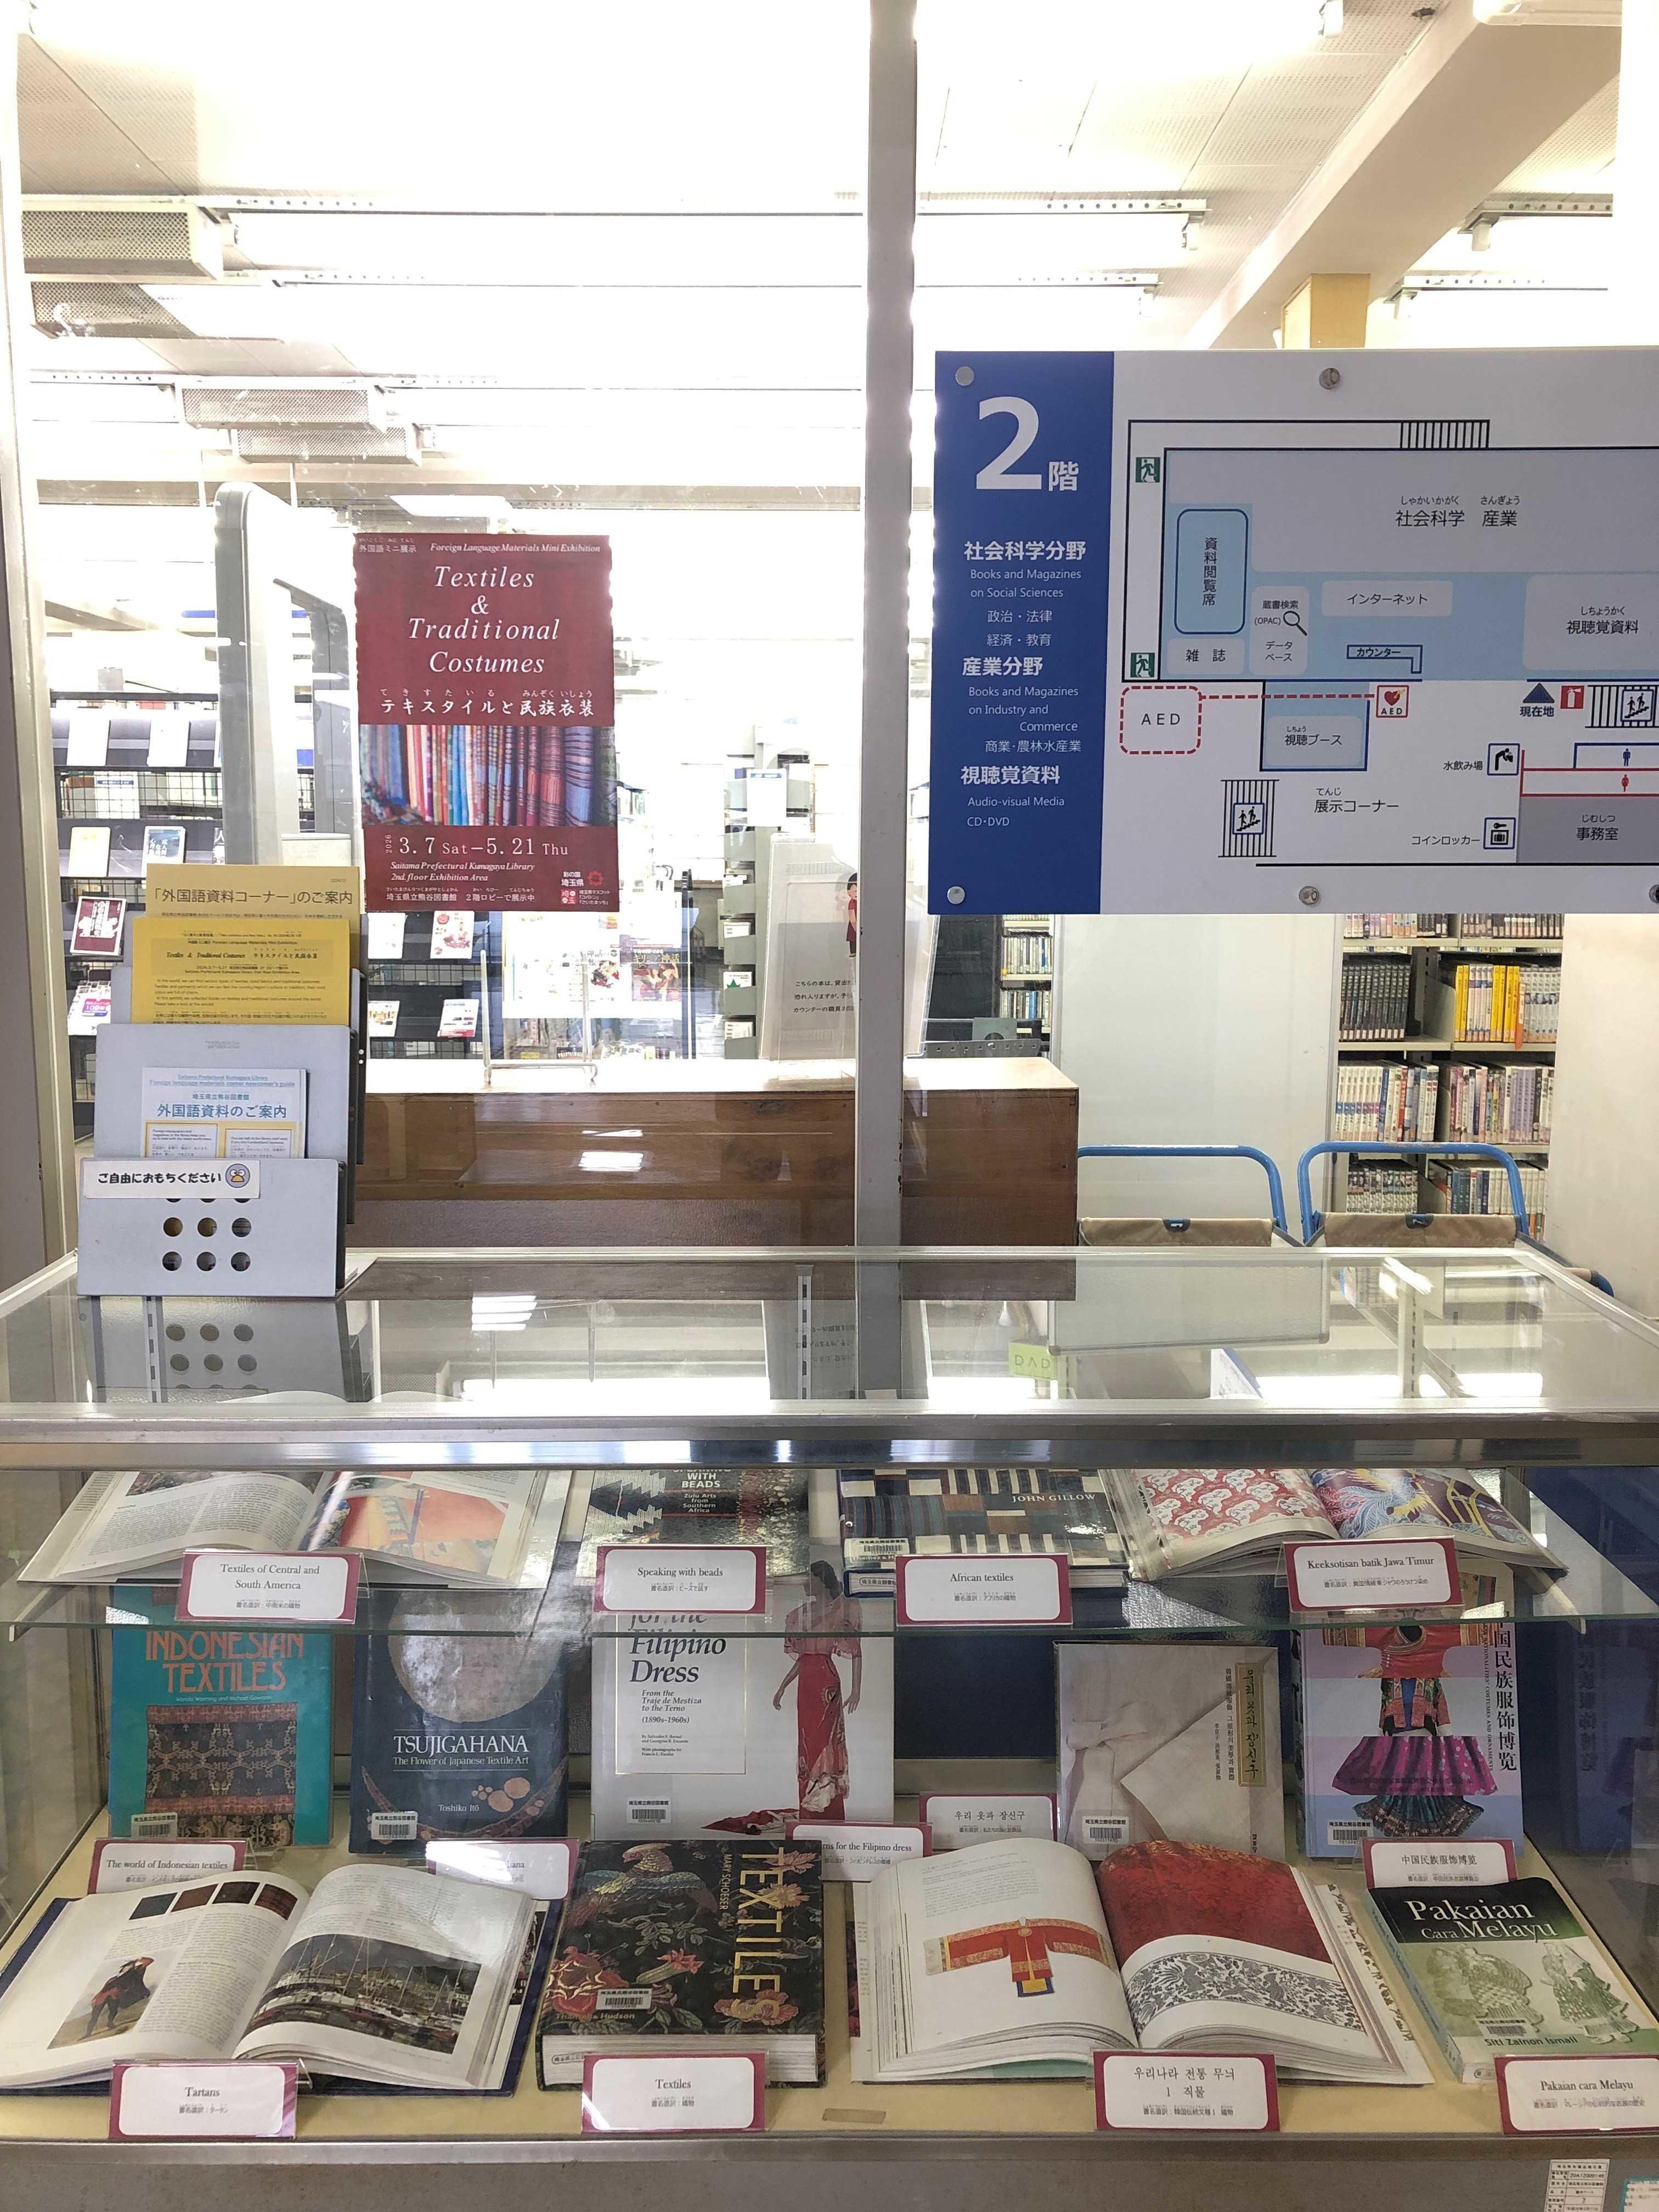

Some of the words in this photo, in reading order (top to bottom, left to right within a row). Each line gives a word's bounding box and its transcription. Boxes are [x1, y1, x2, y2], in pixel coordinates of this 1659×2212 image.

[1400, 495, 1459, 506] しゃかいかがく
[1480, 495, 1521, 506] さんぎょう
[1395, 509, 1465, 527] 社会科学
[1482, 509, 1517, 527] 産業
[430, 543, 462, 553] Foreign
[464, 543, 501, 554] Language
[500, 543, 540, 552] Materials
[540, 543, 560, 552] Mini
[561, 543, 601, 553] Exhibition
[963, 540, 1087, 561] 社会科学分野
[434, 566, 535, 588] Textiles
[970, 568, 1002, 580] Books
[1004, 568, 1024, 580] and
[1026, 568, 1081, 582] Magazines
[1201, 536, 1217, 607] 資料閲覧席
[970, 589, 985, 598] on
[987, 587, 1019, 598] Social
[1020, 587, 1064, 598] Sciences
[1347, 592, 1429, 605] インターネット
[470, 594, 489, 615] &
[1262, 600, 1299, 610] 蔵書検索
[1581, 605, 1626, 616] しちょうかく
[987, 609, 1053, 624] 政治・法律
[1254, 616, 1281, 627] (OPAC)
[408, 618, 560, 640] Traditional
[1566, 620, 1639, 634] 視聴覚資料
[986, 633, 1052, 647] 経済・教育
[1265, 640, 1293, 651] データ
[1265, 652, 1293, 662] ベース
[1357, 647, 1401, 658] カウンター
[429, 651, 545, 674] Costumes
[962, 656, 1043, 676] 産業分野
[968, 686, 1000, 697] Books
[1002, 686, 1022, 697] and
[1024, 686, 1079, 699] Magazines
[380, 699, 594, 717] テキスタイルと民族衣装
[969, 706, 982, 714] on
[984, 704, 1026, 717] Industry
[1029, 704, 1049, 714] and
[1520, 706, 1555, 717] 現在地
[1141, 713, 1181, 726] AED
[1020, 721, 1079, 732] Commerce
[985, 740, 1082, 753] 商業・農林水産業
[1284, 734, 1342, 746] 視聴ブース
[1443, 760, 1483, 771] 水飲み場
[961, 765, 1060, 785] 視聴覚資料
[1316, 787, 1341, 796] てんじ
[967, 796, 1030, 807] Audio-visual
[1034, 796, 1065, 807] Media
[1314, 799, 1400, 813] 展示コーナー
[1582, 814, 1616, 823] じむしつ
[1412, 836, 1481, 845] コインロッカー
[1576, 827, 1619, 841] 事務室
[542, 843, 568, 855] Thu
[391, 861, 420, 870] Saitama
[421, 861, 467, 871] Prefectural
[469, 862, 505, 872] Kumagaya
[506, 862, 535, 872] Library
[429, 873, 469, 882] Exhibition
[561, 878, 584, 887] 埼玉県
[155, 888, 353, 905] 「外国語資料コーナー」のご案内
[156, 1103, 287, 1119] 外国語資料のご案内
[97, 1171, 222, 1185] ご自由におもちください
[687, 1472, 716, 1481] WITH
[681, 1481, 721, 1489] BEADS
[1012, 1494, 1046, 1503] JOHN
[1048, 1493, 1096, 1502] GILLOW
[220, 1562, 254, 1575] Textiles
[256, 1562, 267, 1575] of
[268, 1562, 301, 1575] Central
[303, 1562, 320, 1575] and
[1307, 1559, 1359, 1570] Keeksotisan
[1361, 1558, 1382, 1568] batik
[1384, 1557, 1404, 1568] Jawa
[1405, 1556, 1436, 1567] Timur
[637, 1567, 676, 1578] Speaking
[678, 1567, 696, 1577] with
[698, 1567, 724, 1577] beads
[950, 1572, 983, 1583] African
[984, 1572, 1014, 1583] textiles
[234, 1578, 262, 1590] South
[263, 1579, 301, 1590] America
[145, 1631, 304, 1661] INDONESIAN
[629, 1628, 727, 1662] Filipino
[162, 1661, 286, 1693] TEXTILES
[629, 1660, 699, 1683] Dress
[641, 1697, 661, 1706] Traje
[393, 1735, 530, 1757] TSUJIGAHANA
[393, 1757, 409, 1765] The
[410, 1757, 438, 1766] Flower
[438, 1757, 448, 1765] of
[449, 1757, 485, 1767] Japanese
[486, 1757, 514, 1765] Textile
[514, 1756, 529, 1765] Art
[438, 1804, 467, 1813] Toshiko
[954, 1810, 972, 1822] 우리
[977, 1810, 995, 1822] 옷과
[999, 1810, 1026, 1822] 장신구
[836, 1842, 847, 1852] for
[848, 1842, 861, 1852] the
[862, 1842, 891, 1854] Filipino
[892, 1843, 912, 1852] dress
[106, 1859, 122, 1869] The
[123, 1859, 146, 1869] world
[147, 1859, 157, 1869] of
[157, 1859, 200, 1870] Indonesian
[201, 1860, 228, 1870] textiles
[723, 1853, 733, 1871] MARY
[1401, 1854, 1477, 1866] 中国民族服饰博览
[718, 1872, 732, 1911] SCHOESER
[1404, 1899, 1536, 1921] Pakaian
[731, 1847, 785, 2025] TEXTILES
[1421, 1928, 1458, 1940] Cara
[1454, 1920, 1558, 1944] Melayu
[600, 2012, 635, 2020] Hudson
[1485, 2038, 1504, 2046] Siti
[1505, 2038, 1544, 2046] Zainon
[1545, 2036, 1579, 2045] Ismail
[1133, 2067, 1179, 2081] 우리나라
[1185, 2067, 1207, 2081] 전통
[1213, 2067, 1235, 2081] 무늬
[654, 2079, 692, 2090] Textiles
[1540, 2080, 1578, 2091] Pakaian
[1599, 2080, 1634, 2092] Melayu
[185, 2087, 221, 2100] Tartans
[1183, 2086, 1205, 2099] 직물
